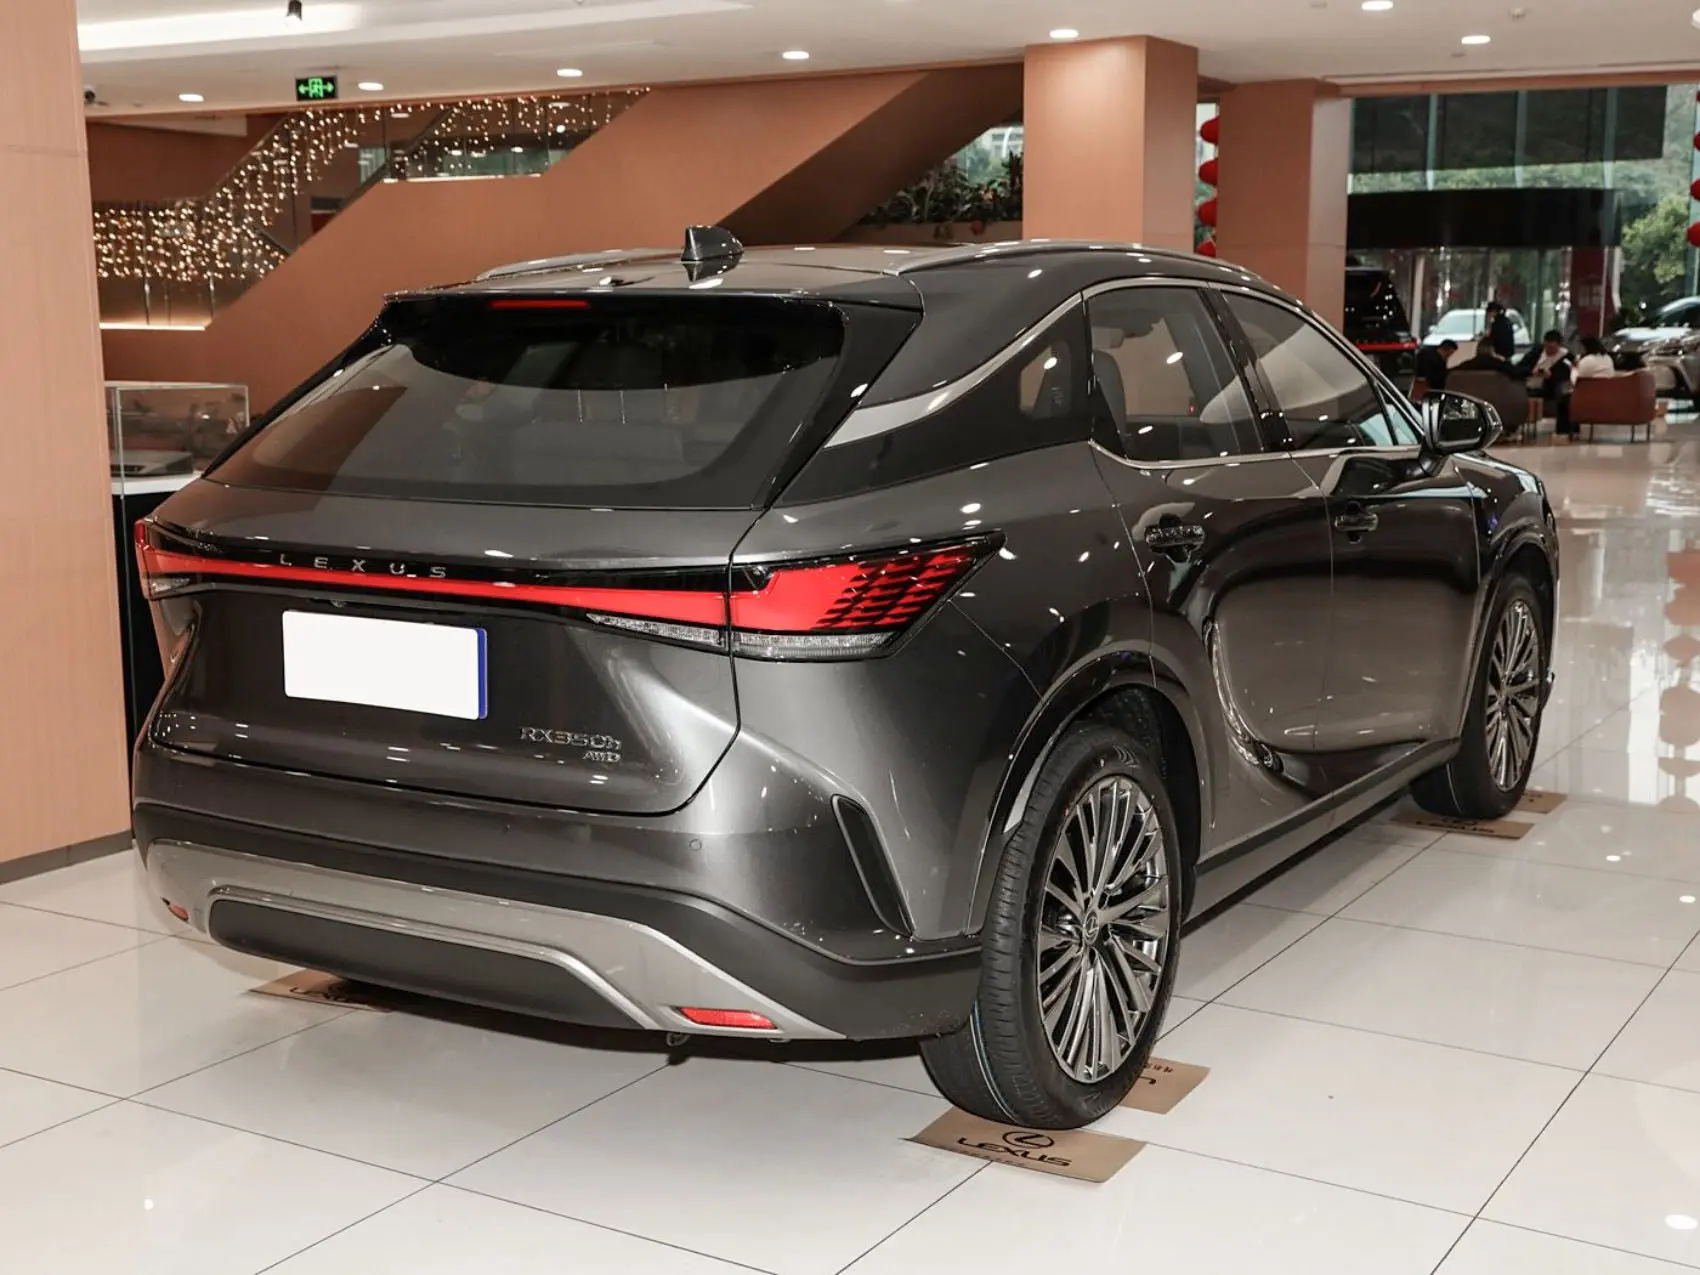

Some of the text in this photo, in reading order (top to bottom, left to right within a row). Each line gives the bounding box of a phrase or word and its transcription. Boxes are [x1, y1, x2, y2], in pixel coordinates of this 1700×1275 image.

[279, 553, 447, 579] LEXUS
[520, 727, 621, 750] RX350h
[581, 750, 621, 762] AWD
[957, 1137, 1073, 1167] LEXUS
